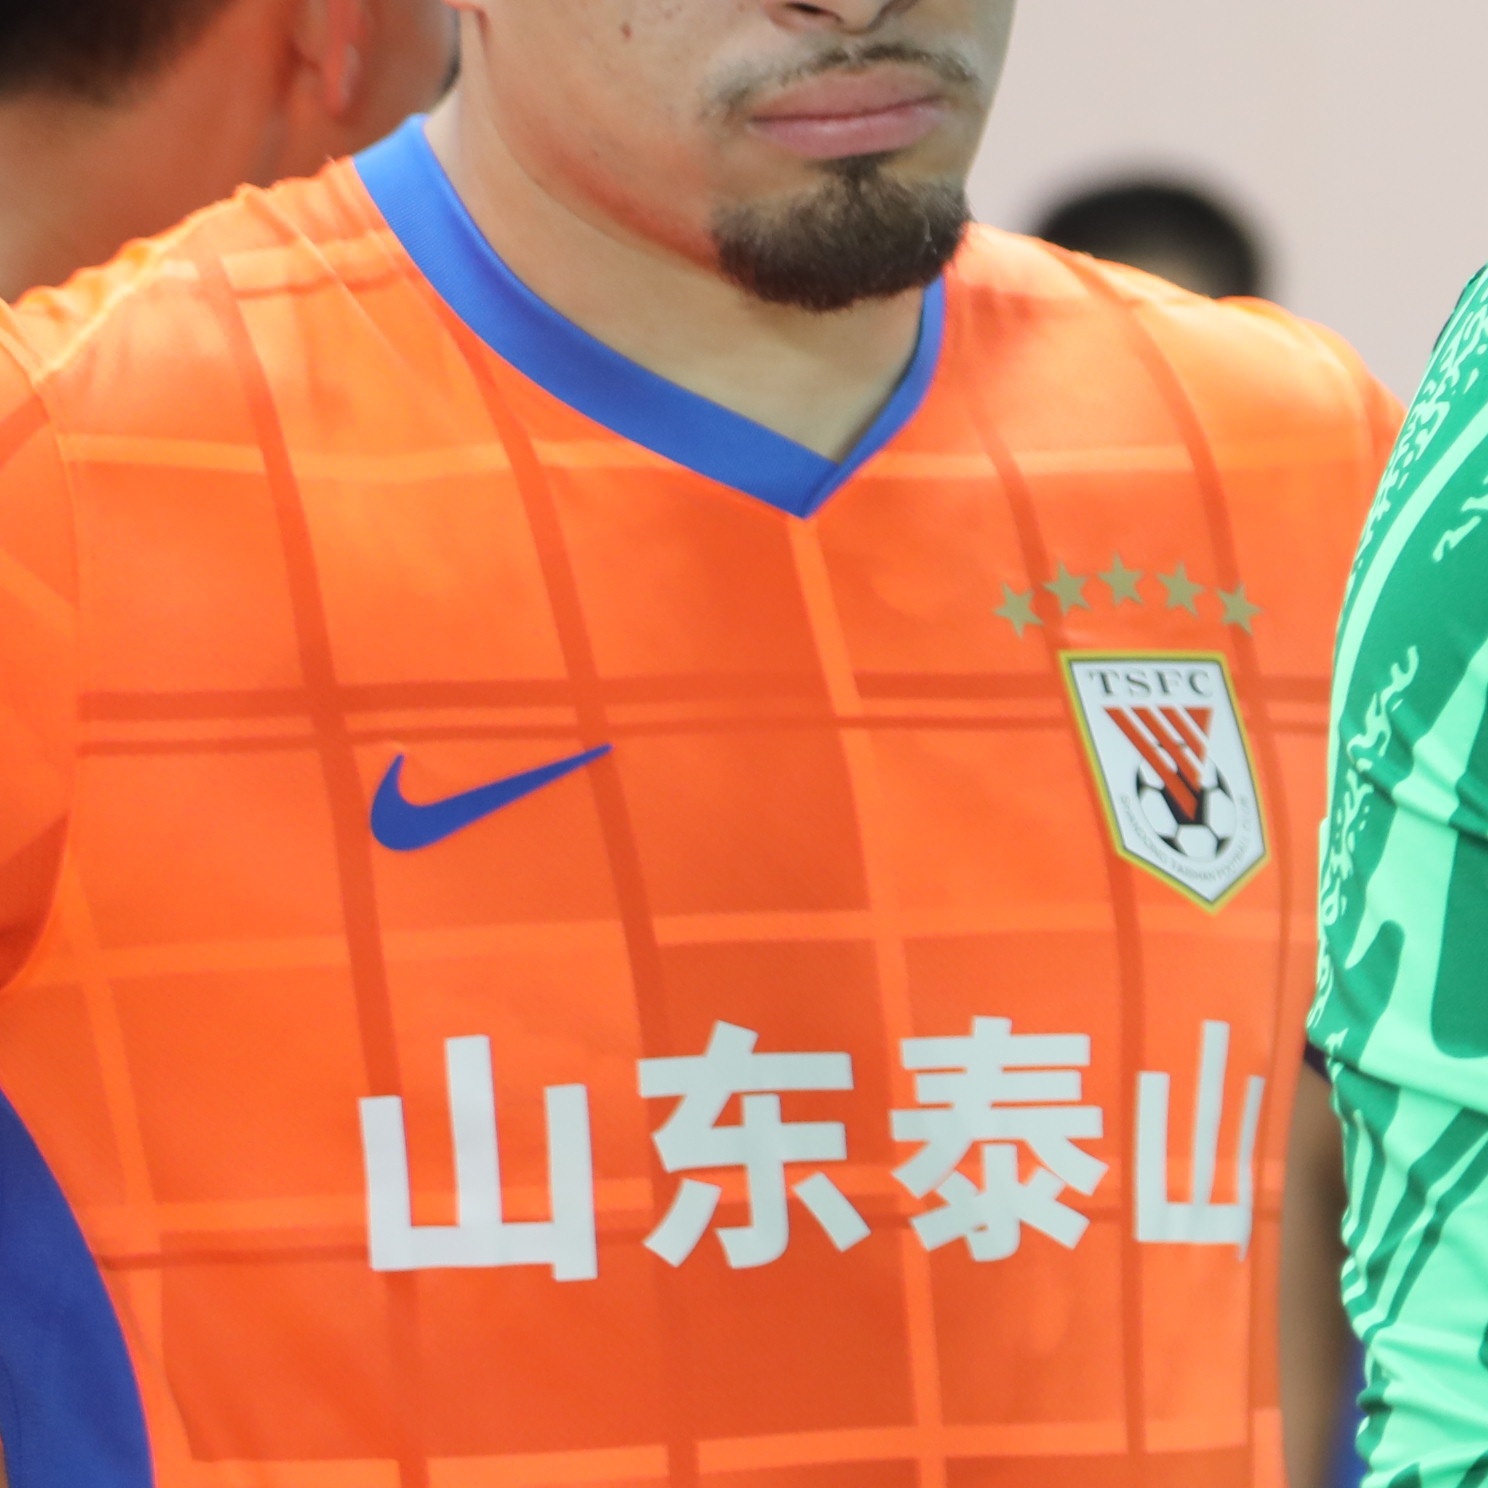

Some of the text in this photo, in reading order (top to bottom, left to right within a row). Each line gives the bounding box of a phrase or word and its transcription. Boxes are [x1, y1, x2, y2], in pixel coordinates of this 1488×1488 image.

[1088, 667, 1213, 698] TSFC
[358, 1016, 1265, 1281] 山东泰山
